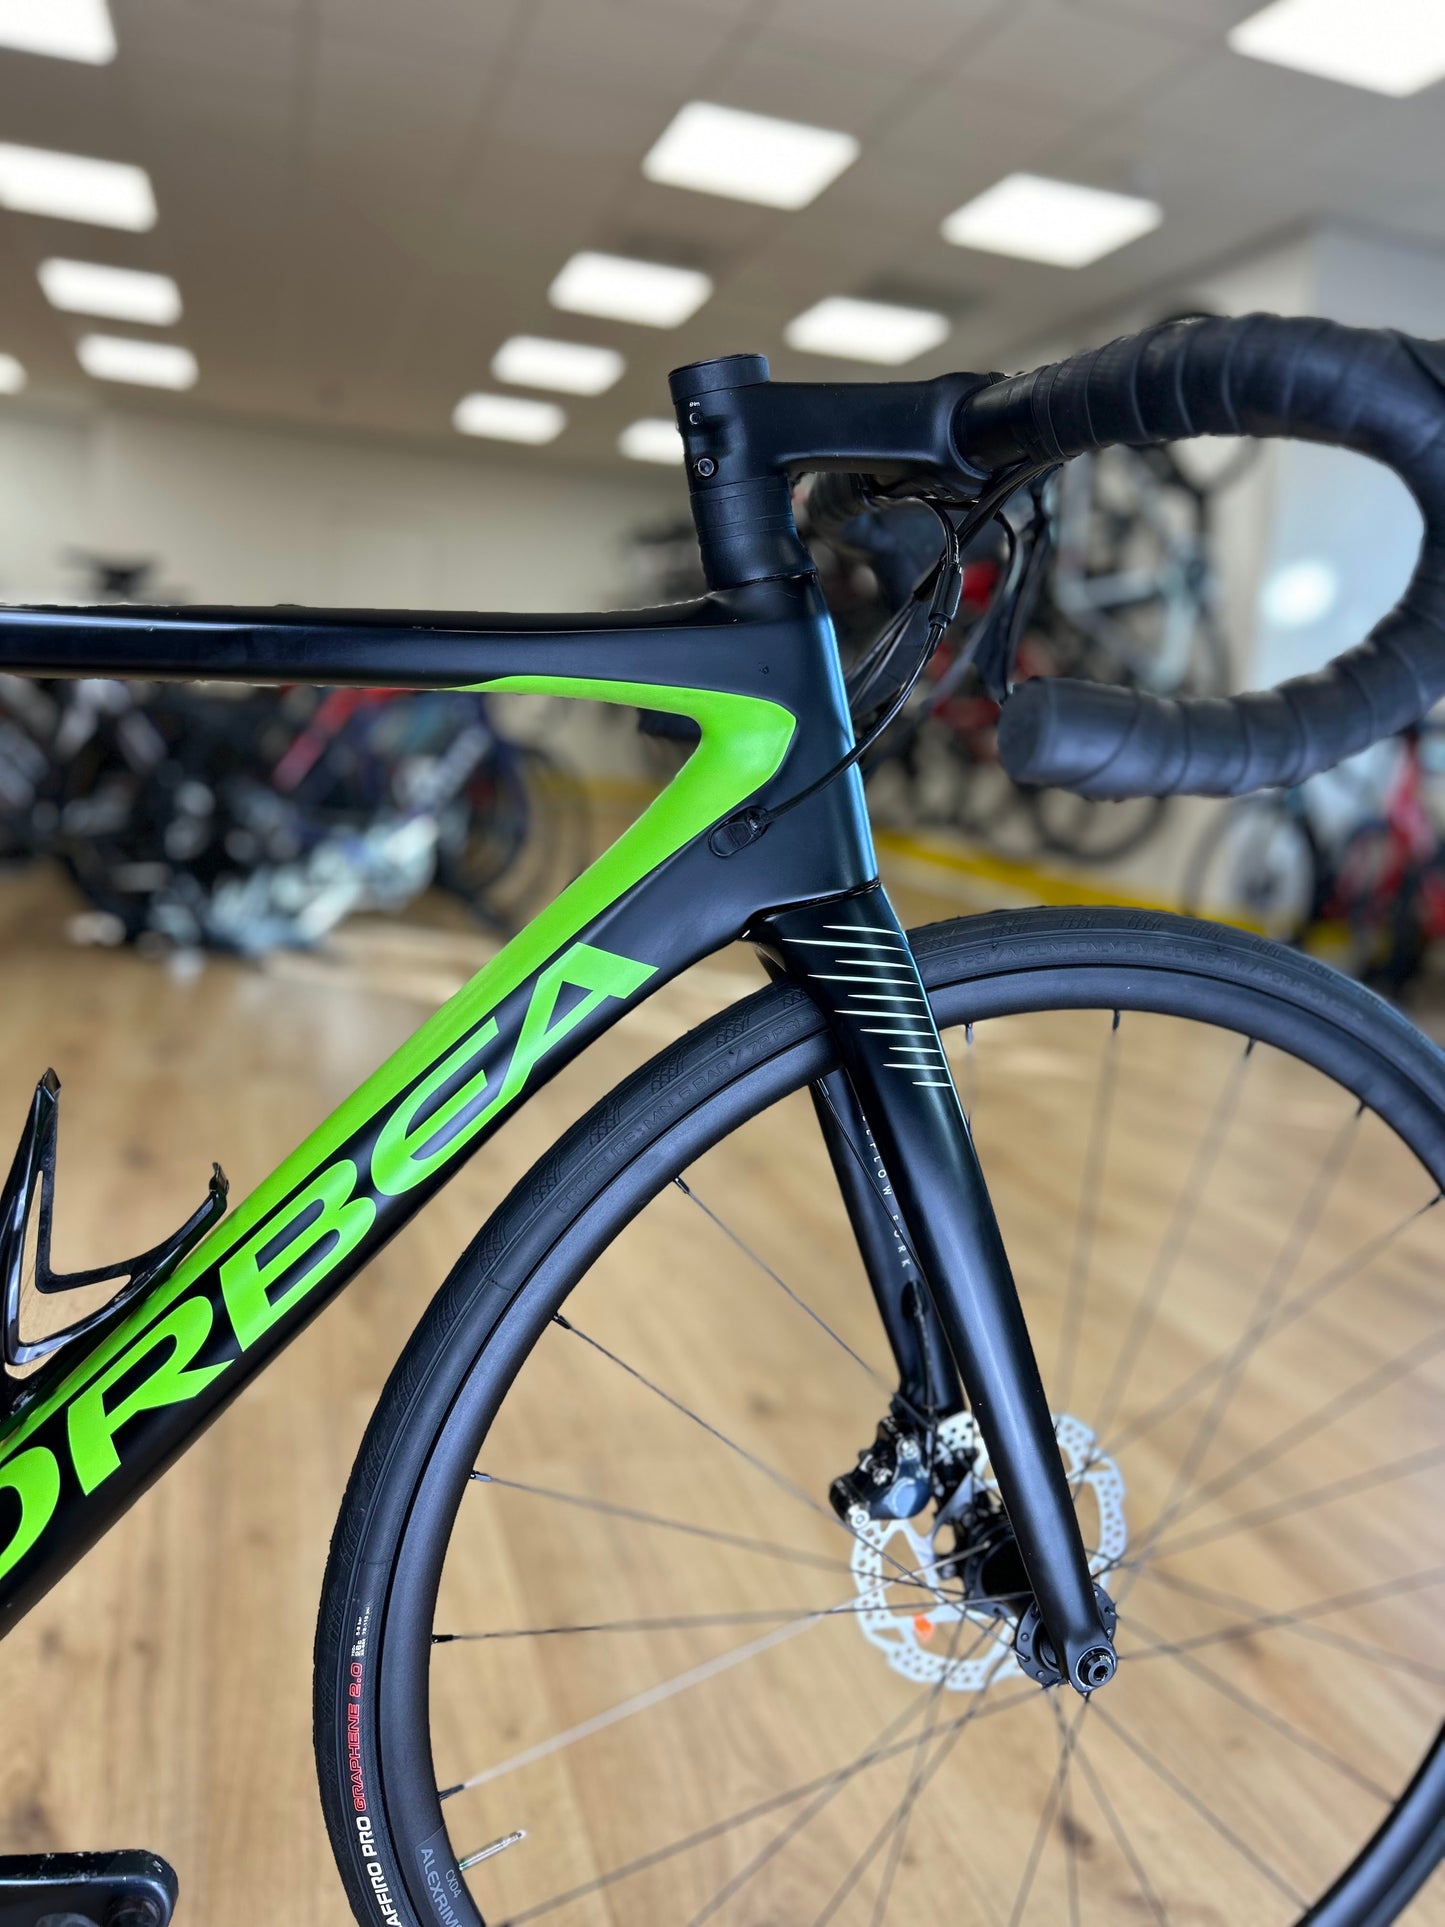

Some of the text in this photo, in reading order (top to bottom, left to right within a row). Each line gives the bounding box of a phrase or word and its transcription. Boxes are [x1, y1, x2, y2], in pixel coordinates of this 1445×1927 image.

[349, 1662, 363, 1698] 2.0
[347, 1703, 367, 1812] GRAPHENE
[356, 1816, 378, 1857] PRO
[445, 1868, 462, 1898] CXD4
